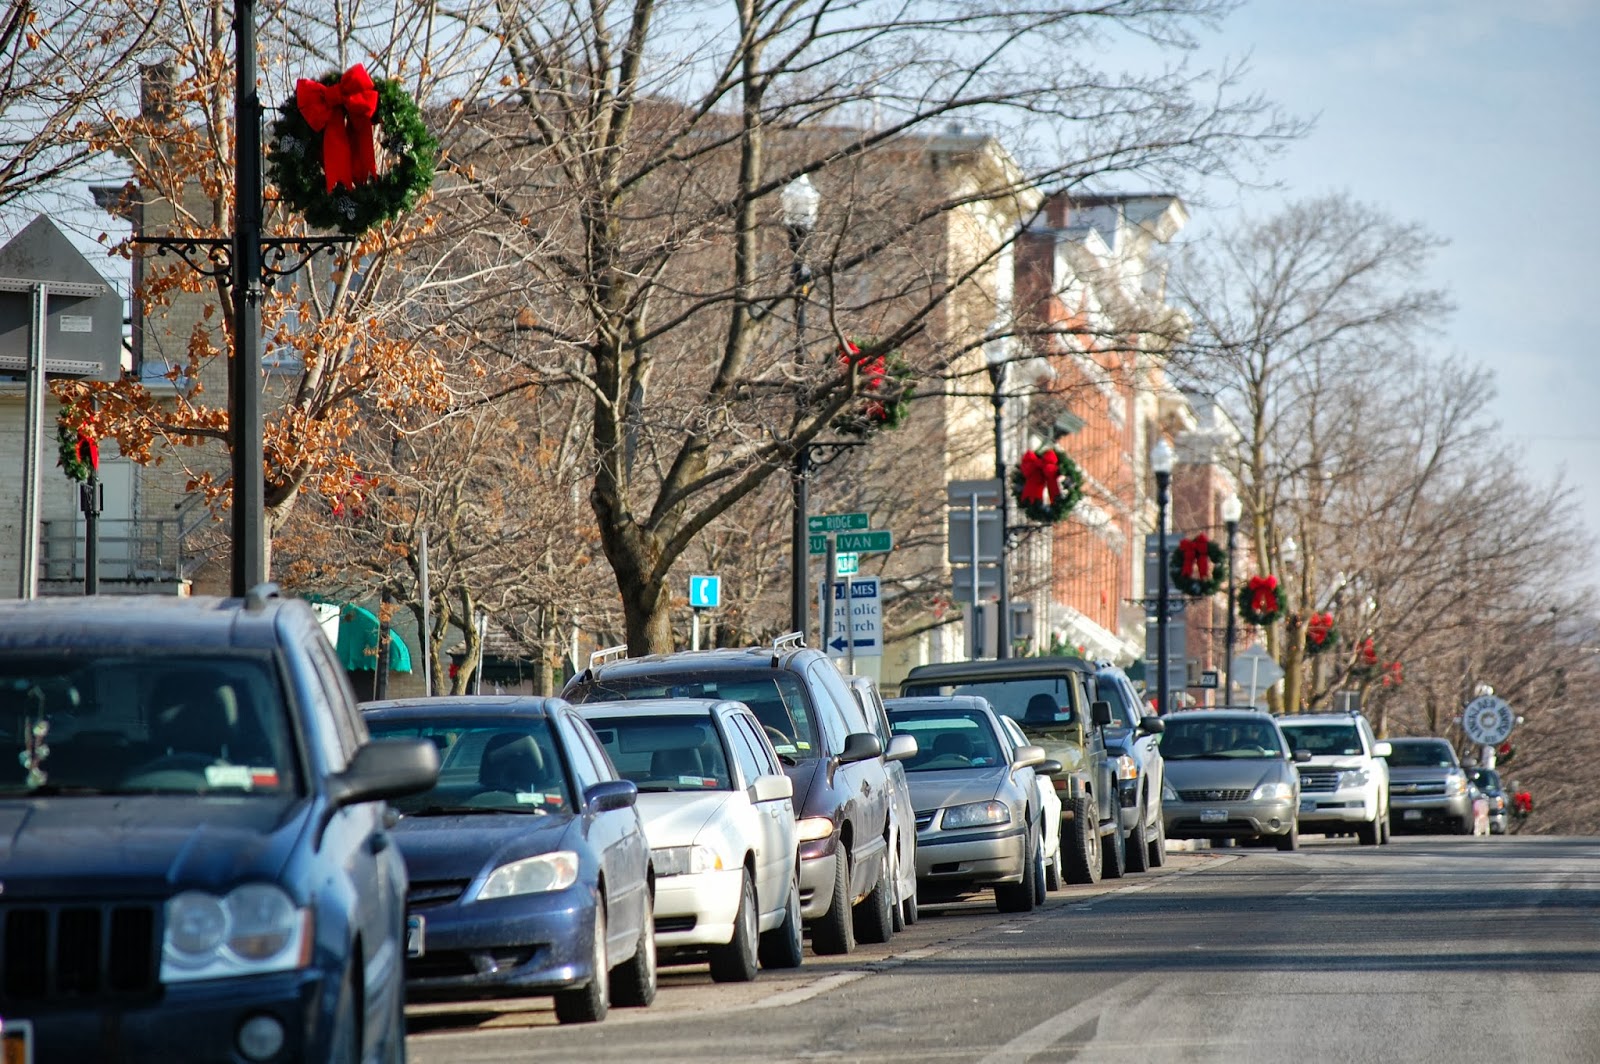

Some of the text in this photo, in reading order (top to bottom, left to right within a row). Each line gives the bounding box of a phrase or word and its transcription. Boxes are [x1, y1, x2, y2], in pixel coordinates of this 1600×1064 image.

[826, 516, 866, 529] RIDGE RD
[808, 536, 872, 551] SULIVAN
[840, 585, 874, 597] JMES
[834, 603, 877, 616] atolic
[833, 619, 874, 632] hrch
